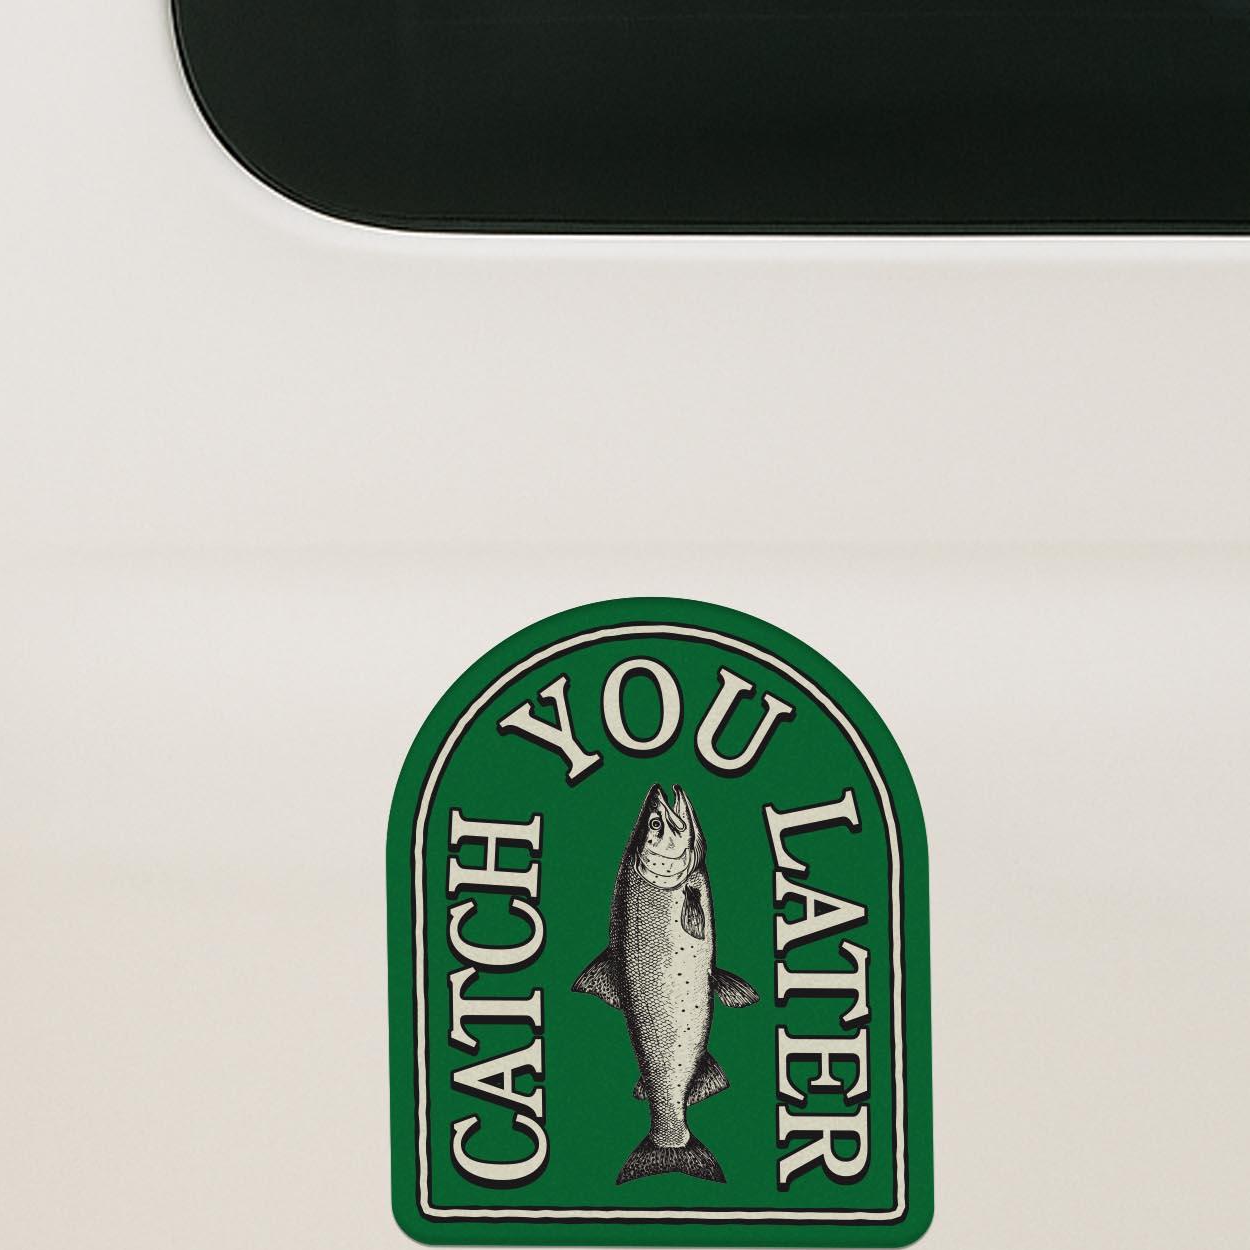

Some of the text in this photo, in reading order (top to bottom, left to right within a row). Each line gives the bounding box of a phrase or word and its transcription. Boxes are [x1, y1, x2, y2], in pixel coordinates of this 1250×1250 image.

[447, 656, 869, 1188] CATCH YOU LATER
